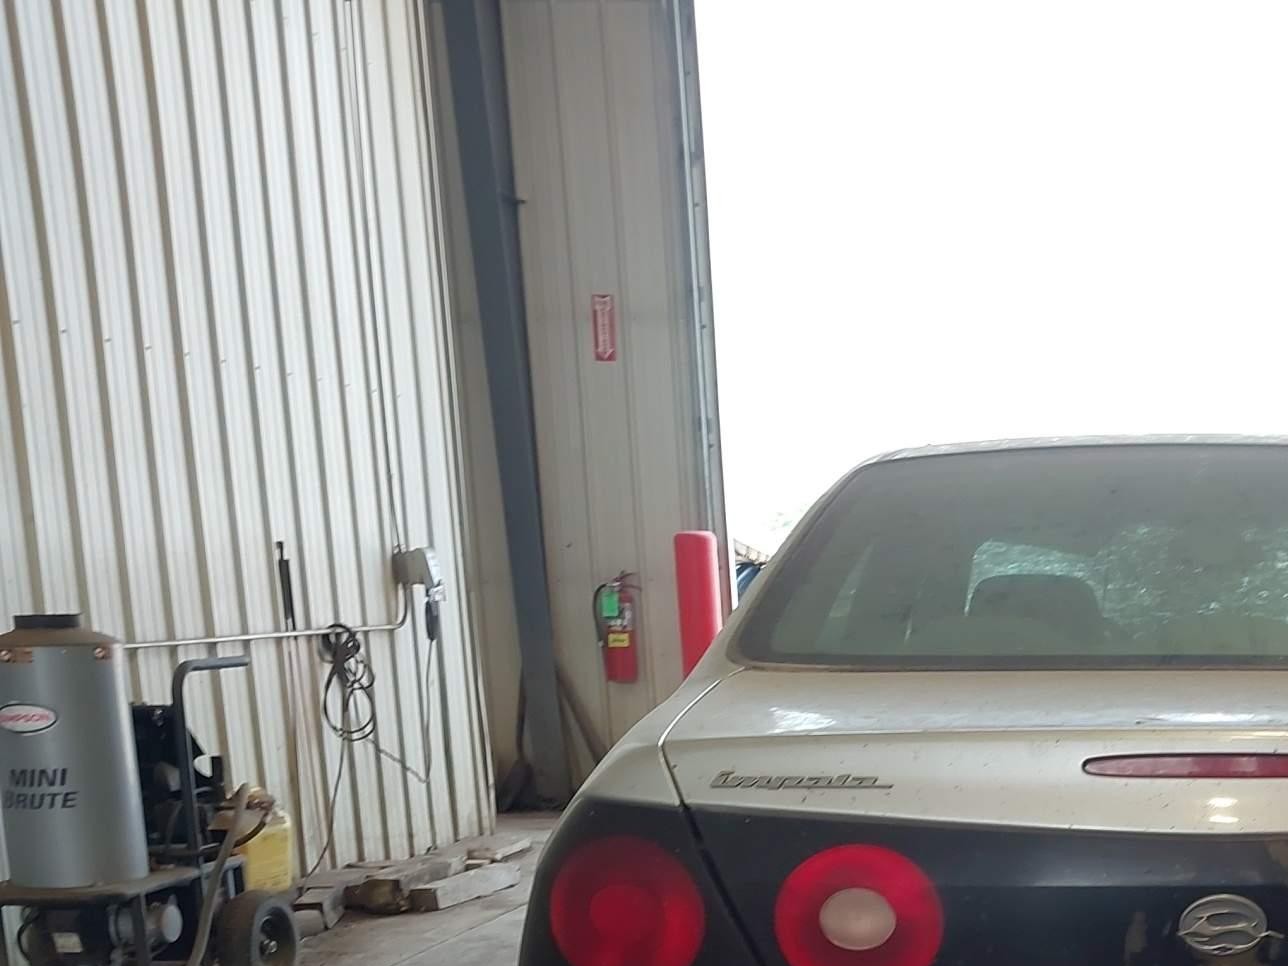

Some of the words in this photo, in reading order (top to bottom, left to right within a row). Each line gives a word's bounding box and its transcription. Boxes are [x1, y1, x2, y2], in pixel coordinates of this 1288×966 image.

[0, 713, 48, 723] IMPSON
[9, 768, 68, 788] MINI
[3, 791, 80, 810] BRUTE
